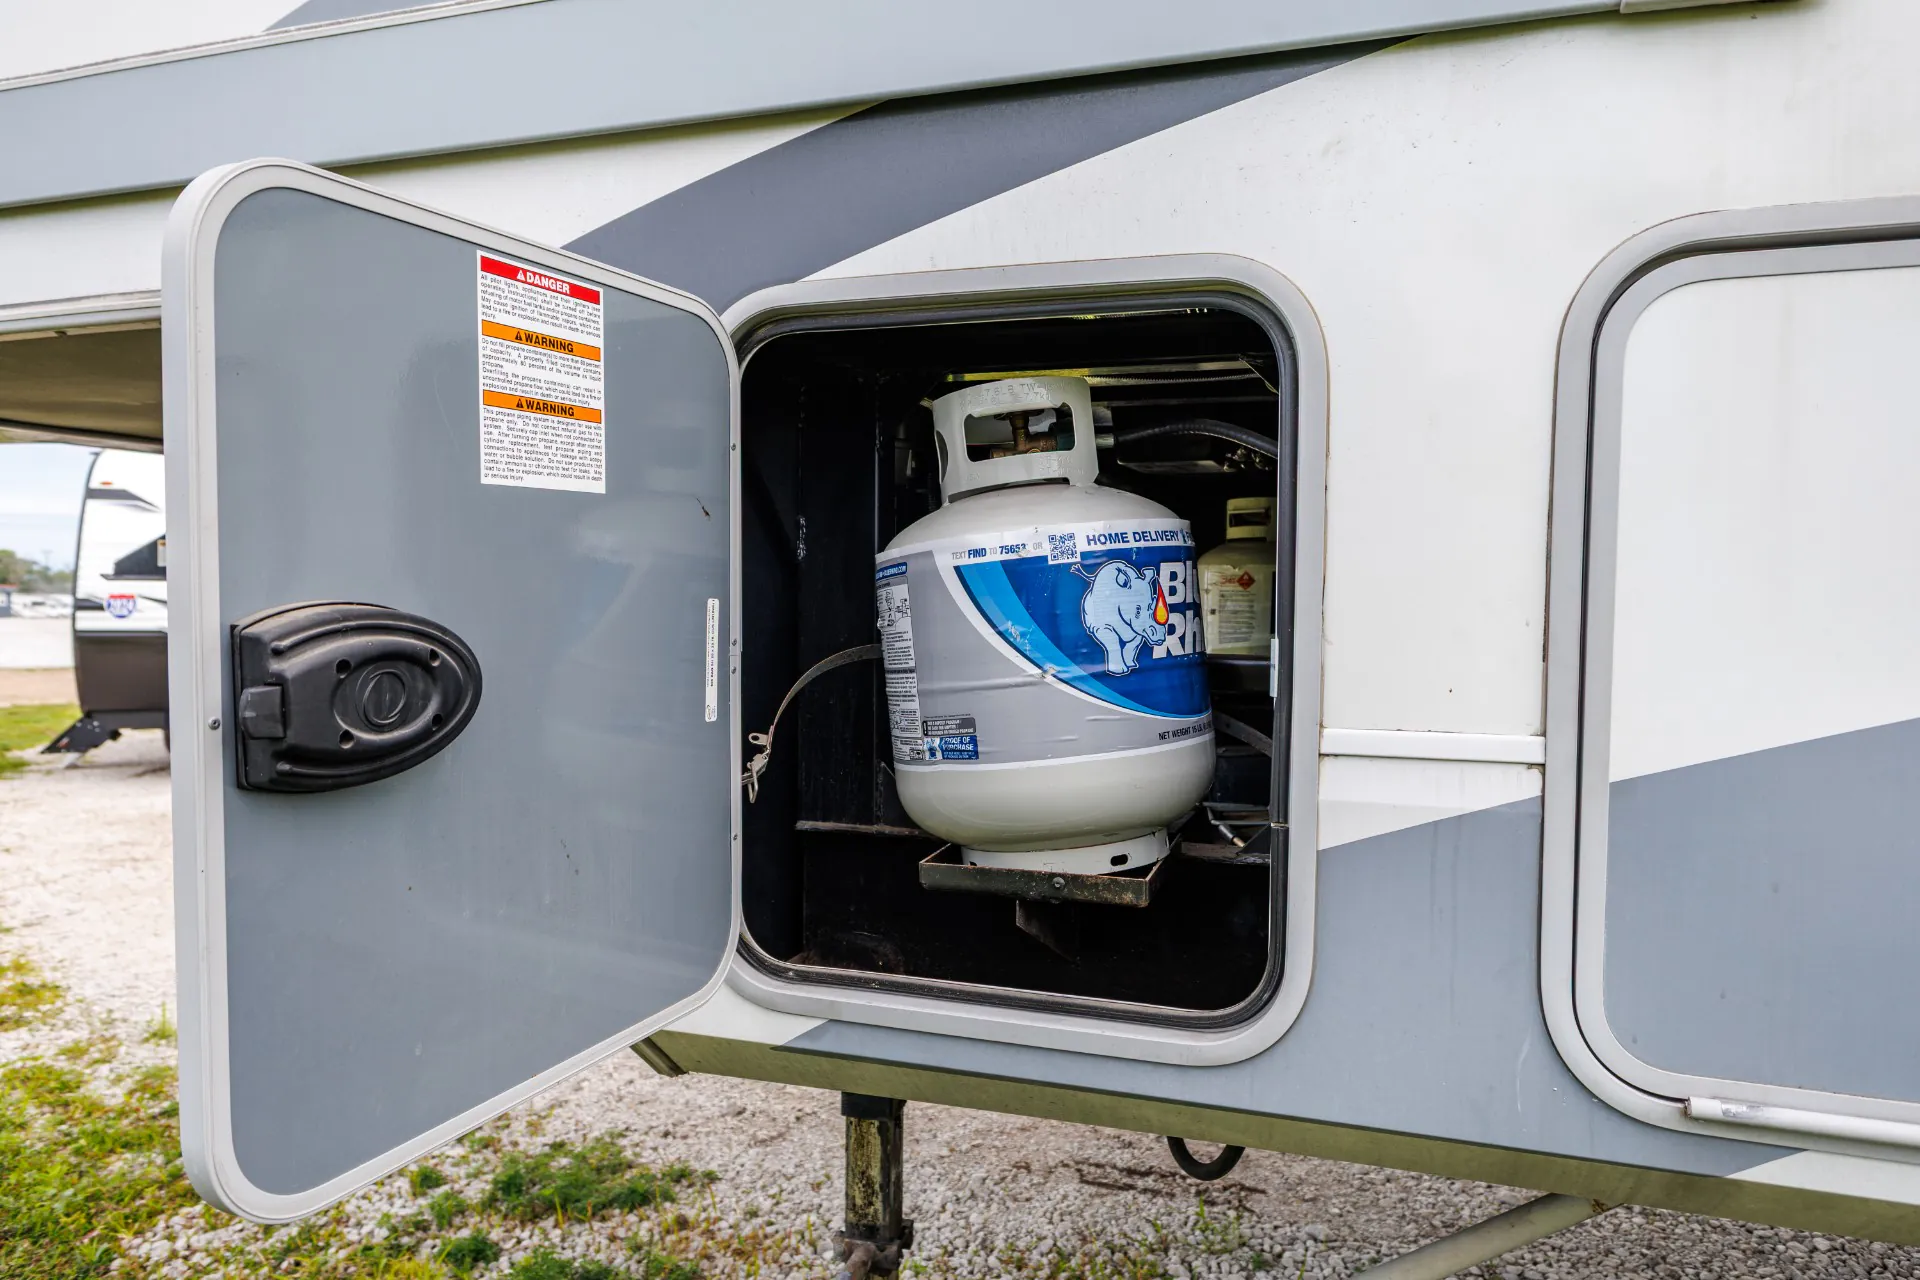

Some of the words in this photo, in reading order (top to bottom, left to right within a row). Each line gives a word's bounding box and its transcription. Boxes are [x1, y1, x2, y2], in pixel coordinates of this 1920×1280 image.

[527, 272, 569, 294] DANGER
[524, 332, 574, 353] WARNING
[525, 399, 574, 416] WARNING
[1086, 532, 1130, 546] HOME
[1132, 530, 1180, 543] DELIVERY
[952, 551, 967, 560] TEXT
[968, 548, 986, 559] FIND
[989, 547, 997, 555] TO
[1033, 542, 1042, 550] OR
[1152, 610, 1206, 659] Rh
[1158, 731, 1170, 740] NET
[1172, 727, 1191, 738] WEIGHT
